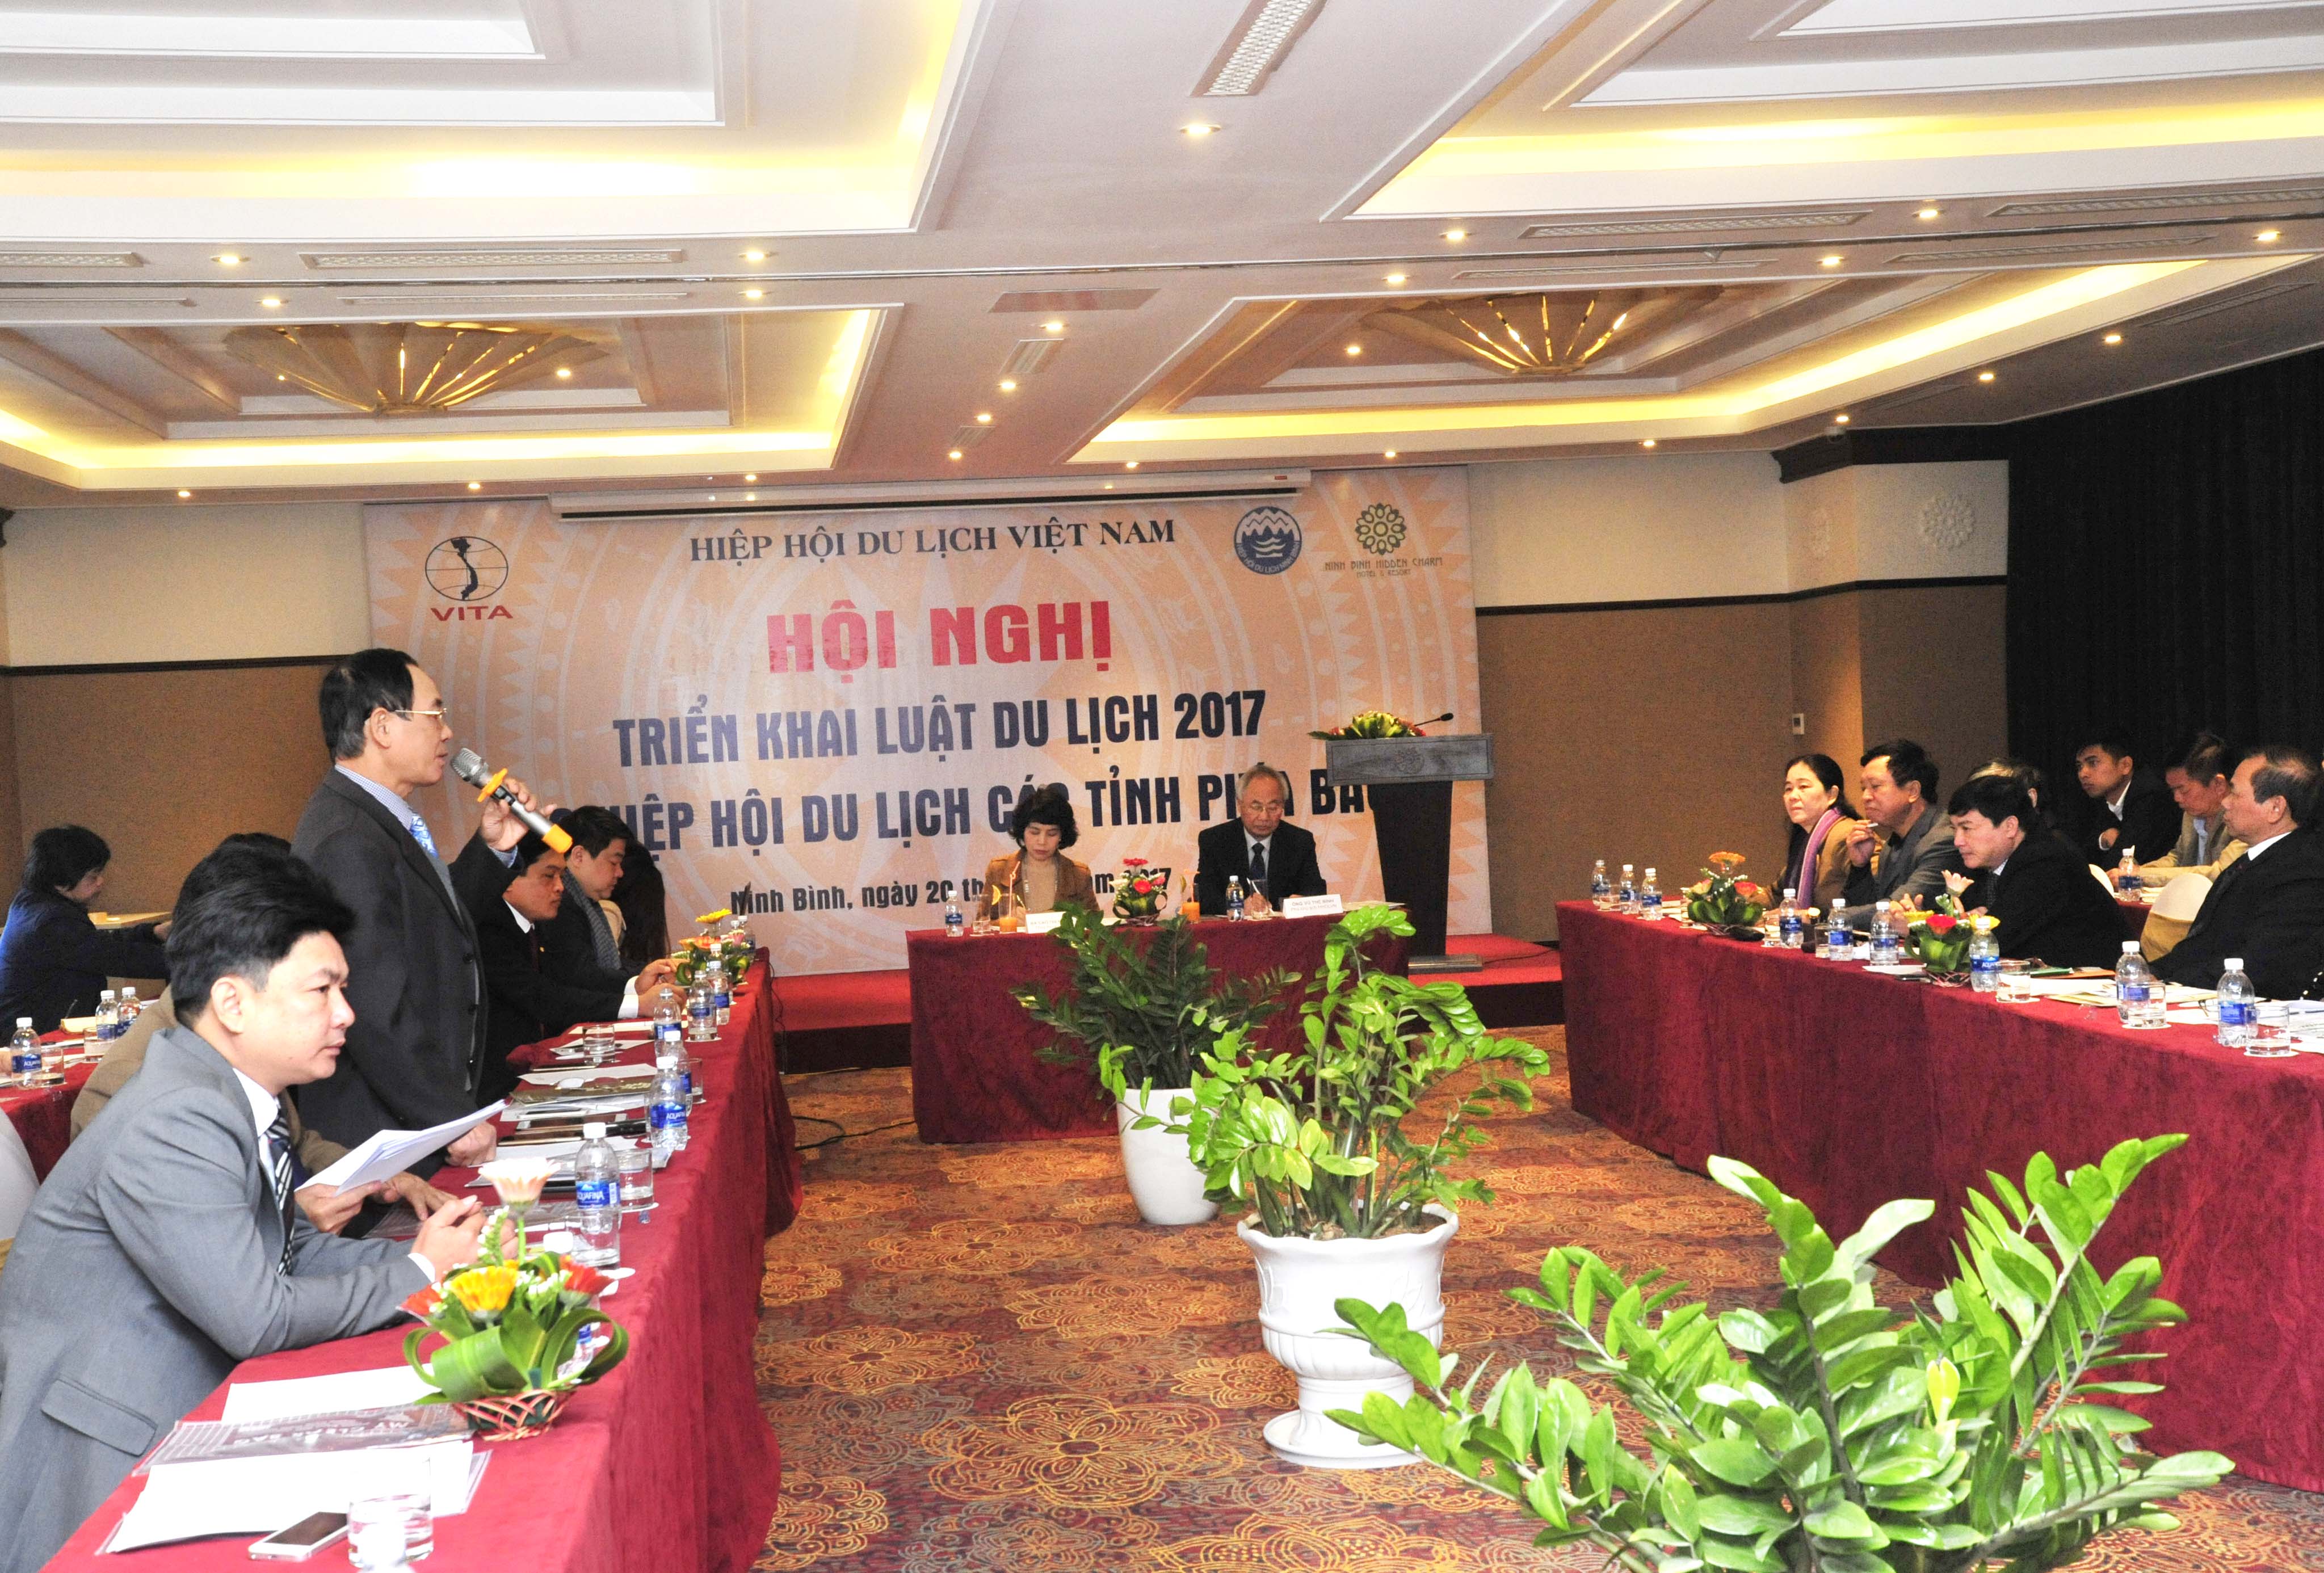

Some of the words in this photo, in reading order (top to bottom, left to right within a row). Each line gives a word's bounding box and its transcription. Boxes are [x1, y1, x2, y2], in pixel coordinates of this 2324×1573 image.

[691, 528, 772, 566] HIỆP
[784, 525, 845, 563] HỘI
[858, 531, 903, 555] DU
[915, 527, 997, 558] LỊCH
[1007, 516, 1089, 554] VIỆT
[1099, 519, 1175, 545] NAM
[1376, 558, 1407, 569] HIDDEN
[1412, 557, 1443, 567] CHARM
[431, 605, 513, 621] VITA
[767, 599, 897, 683] HỘI
[930, 601, 1112, 671] NGHỊ
[613, 694, 739, 767] TRIỂN
[756, 709, 858, 760] KHAI
[875, 694, 976, 762] LUẬT
[993, 699, 1049, 748] DU
[1066, 694, 1159, 754] LỊCH
[1174, 689, 1266, 739] 2017
[600, 793, 694, 861] IỆP
[711, 788, 784, 856] HỘI
[801, 793, 858, 843] DU
[876, 788, 970, 848] LỊCH
[1085, 765, 1180, 827] TỈNH
[731, 889, 784, 915] Ninh
[793, 885, 853, 910] Bình,
[861, 881, 918, 908] ngày
[926, 880, 953, 903] 20
